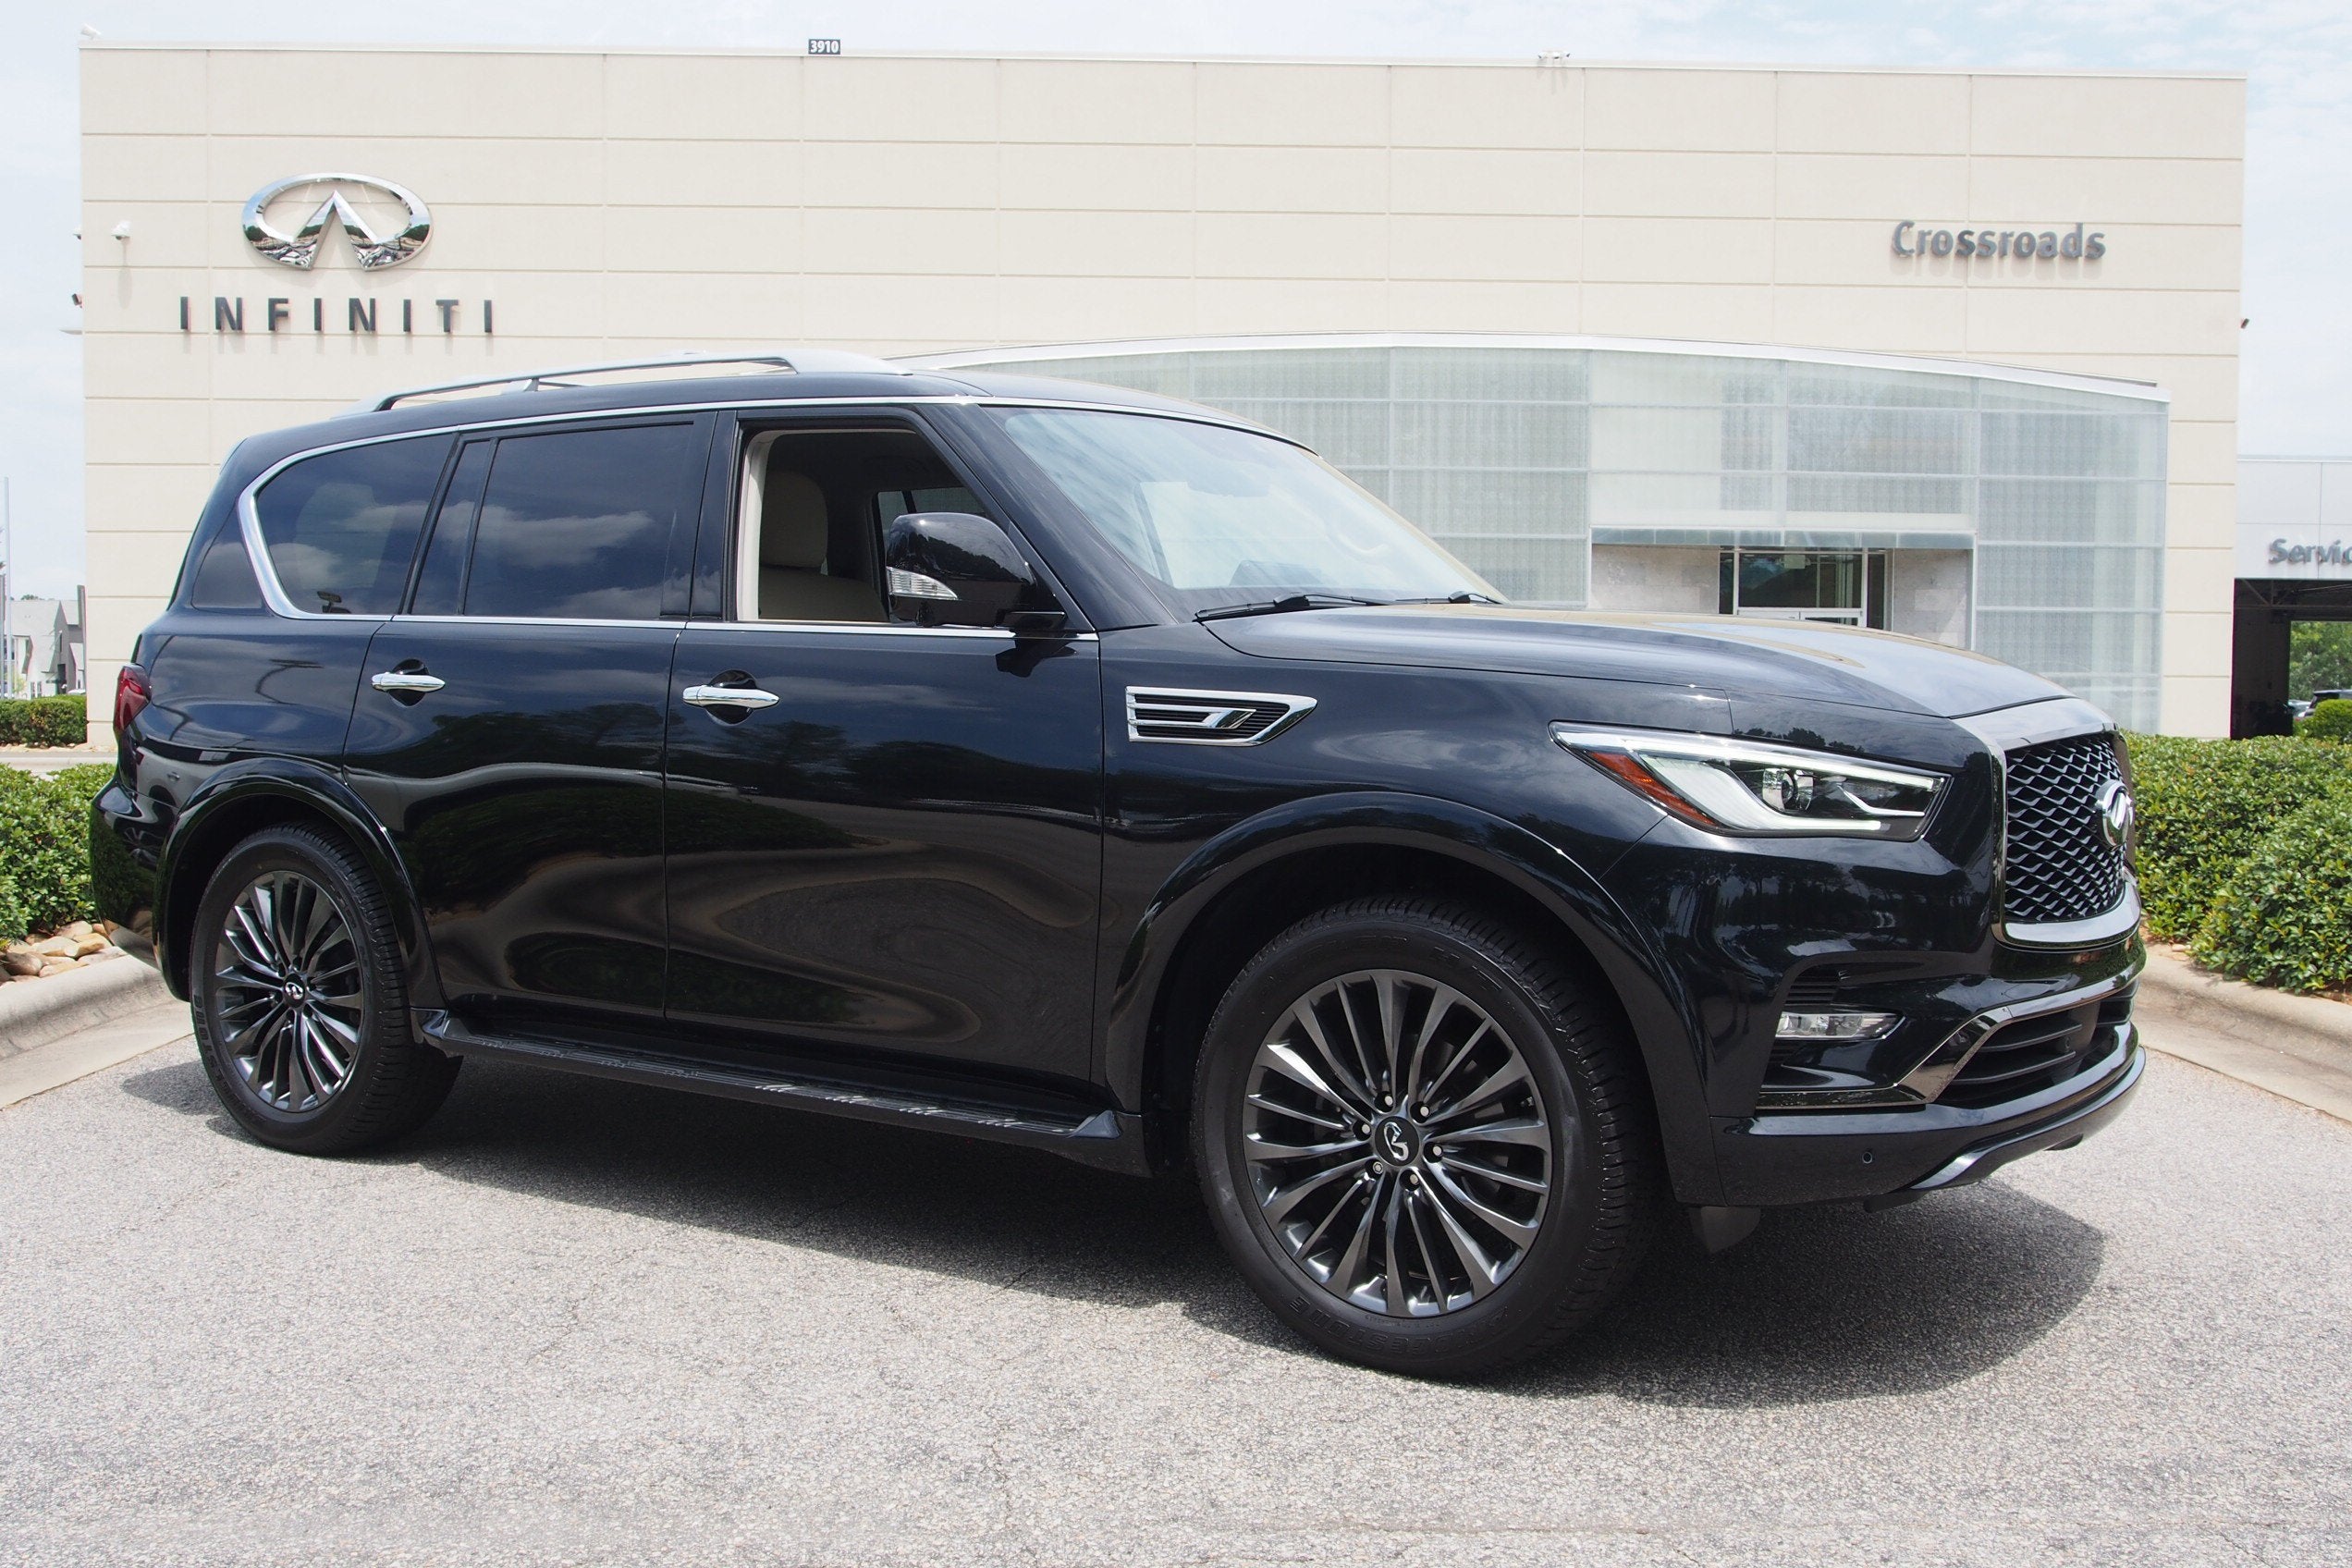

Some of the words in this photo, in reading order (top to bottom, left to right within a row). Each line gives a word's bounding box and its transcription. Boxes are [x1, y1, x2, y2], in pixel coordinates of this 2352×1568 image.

[809, 40, 840, 54] 3910
[1892, 220, 2106, 260] Crossroads
[179, 296, 494, 334] INFINITI
